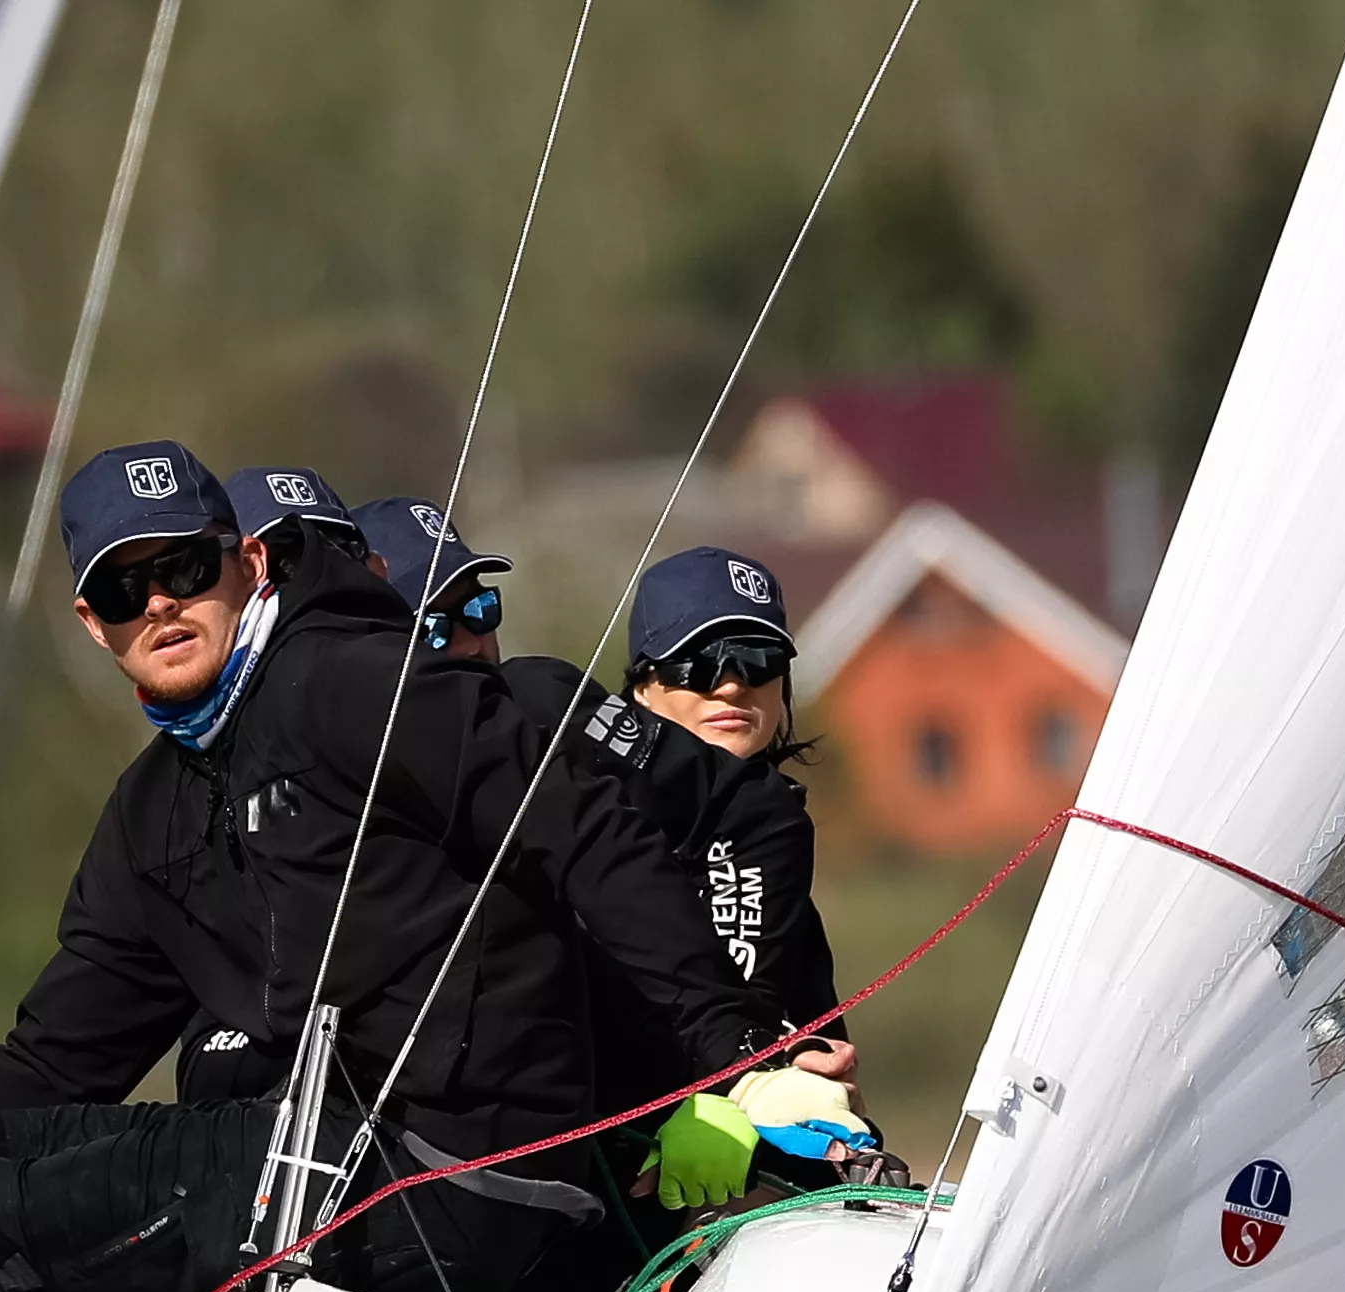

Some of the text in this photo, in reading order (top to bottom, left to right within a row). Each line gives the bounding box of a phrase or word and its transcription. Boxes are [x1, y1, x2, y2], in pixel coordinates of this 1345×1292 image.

[739, 866, 763, 940] TEAM
[1250, 1165, 1283, 1208] U
[1233, 1220, 1263, 1263] S
